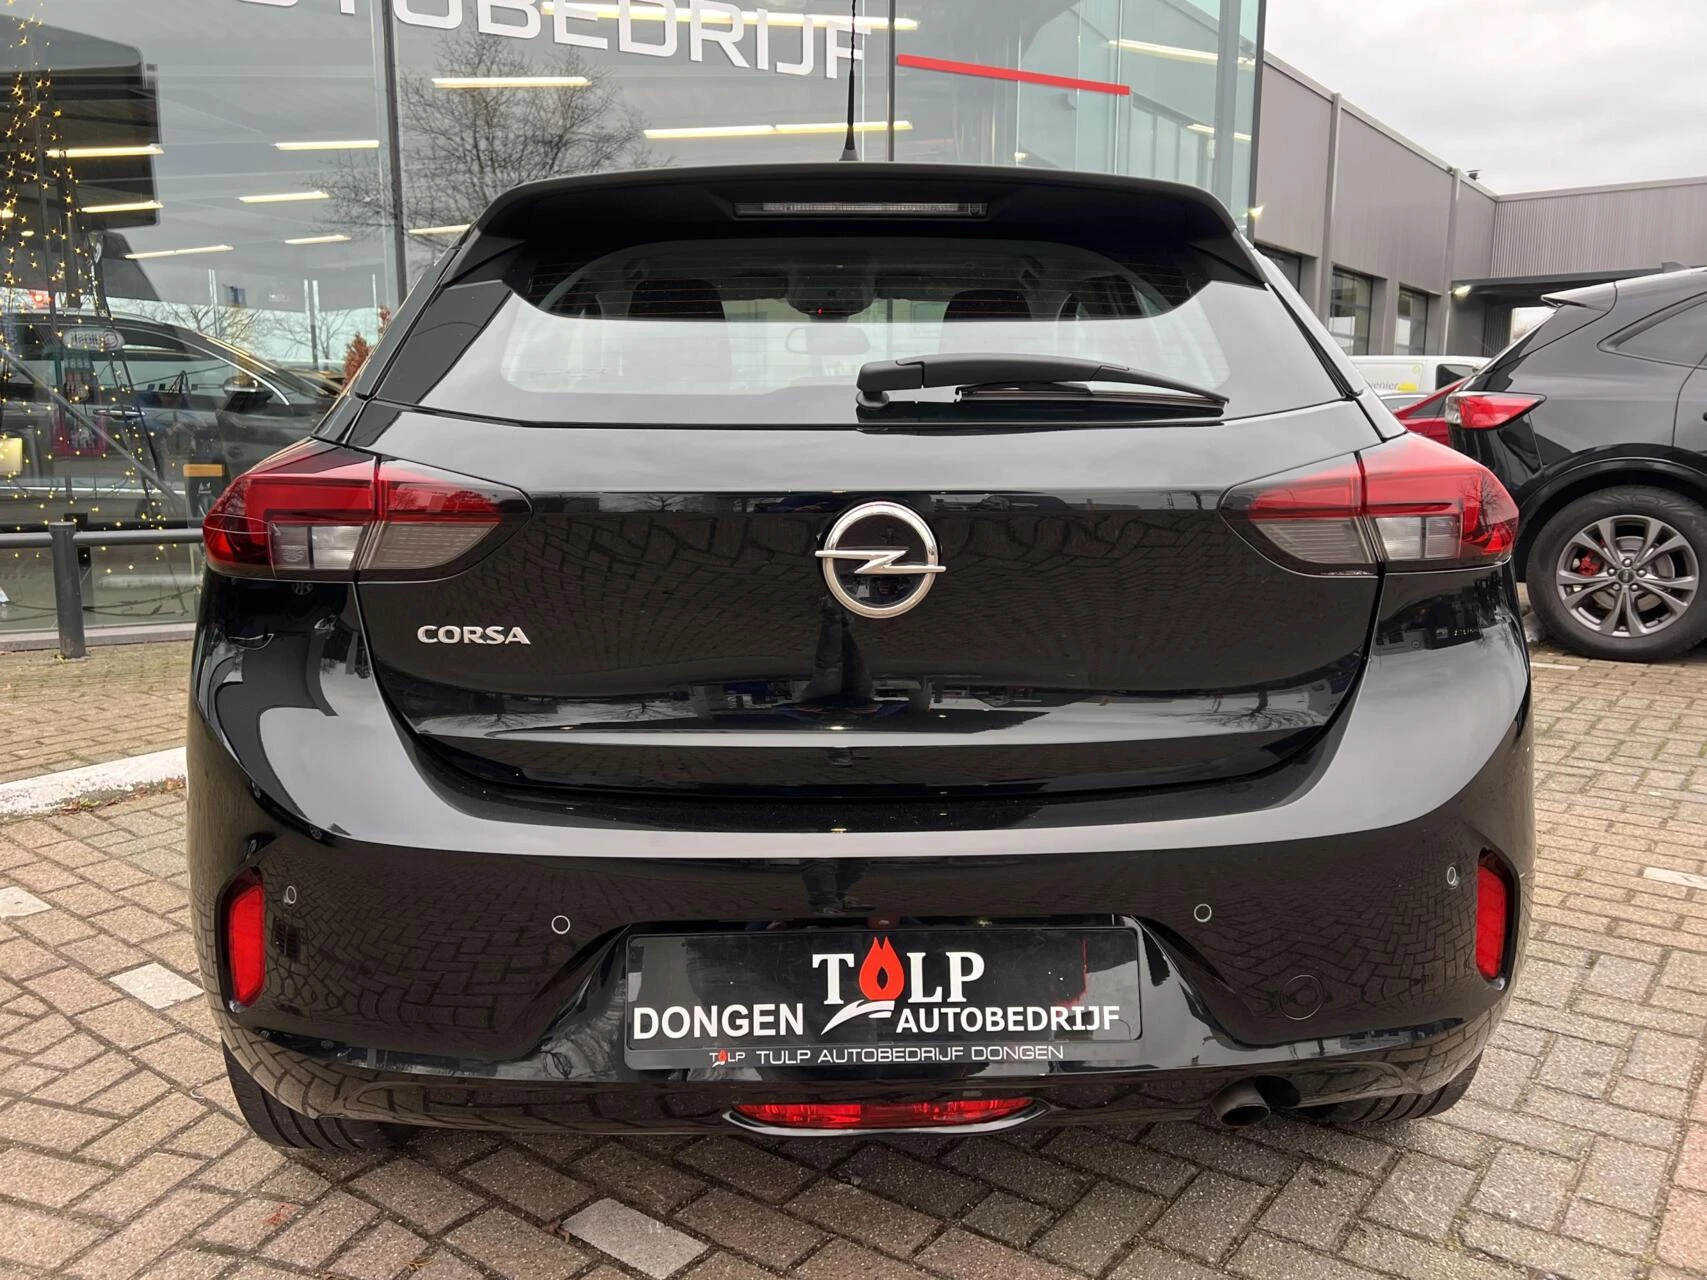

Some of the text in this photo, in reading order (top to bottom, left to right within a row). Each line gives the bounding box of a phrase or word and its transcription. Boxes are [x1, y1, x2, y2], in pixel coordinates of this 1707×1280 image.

[417, 625, 531, 645] CORSA
[633, 1003, 1120, 1040] DONGEN AUTOBEDRIJF
[756, 1050, 810, 1064] TULP
[818, 1047, 963, 1063] AUTOBEDRIJF
[972, 1045, 1063, 1060] DONGEN
